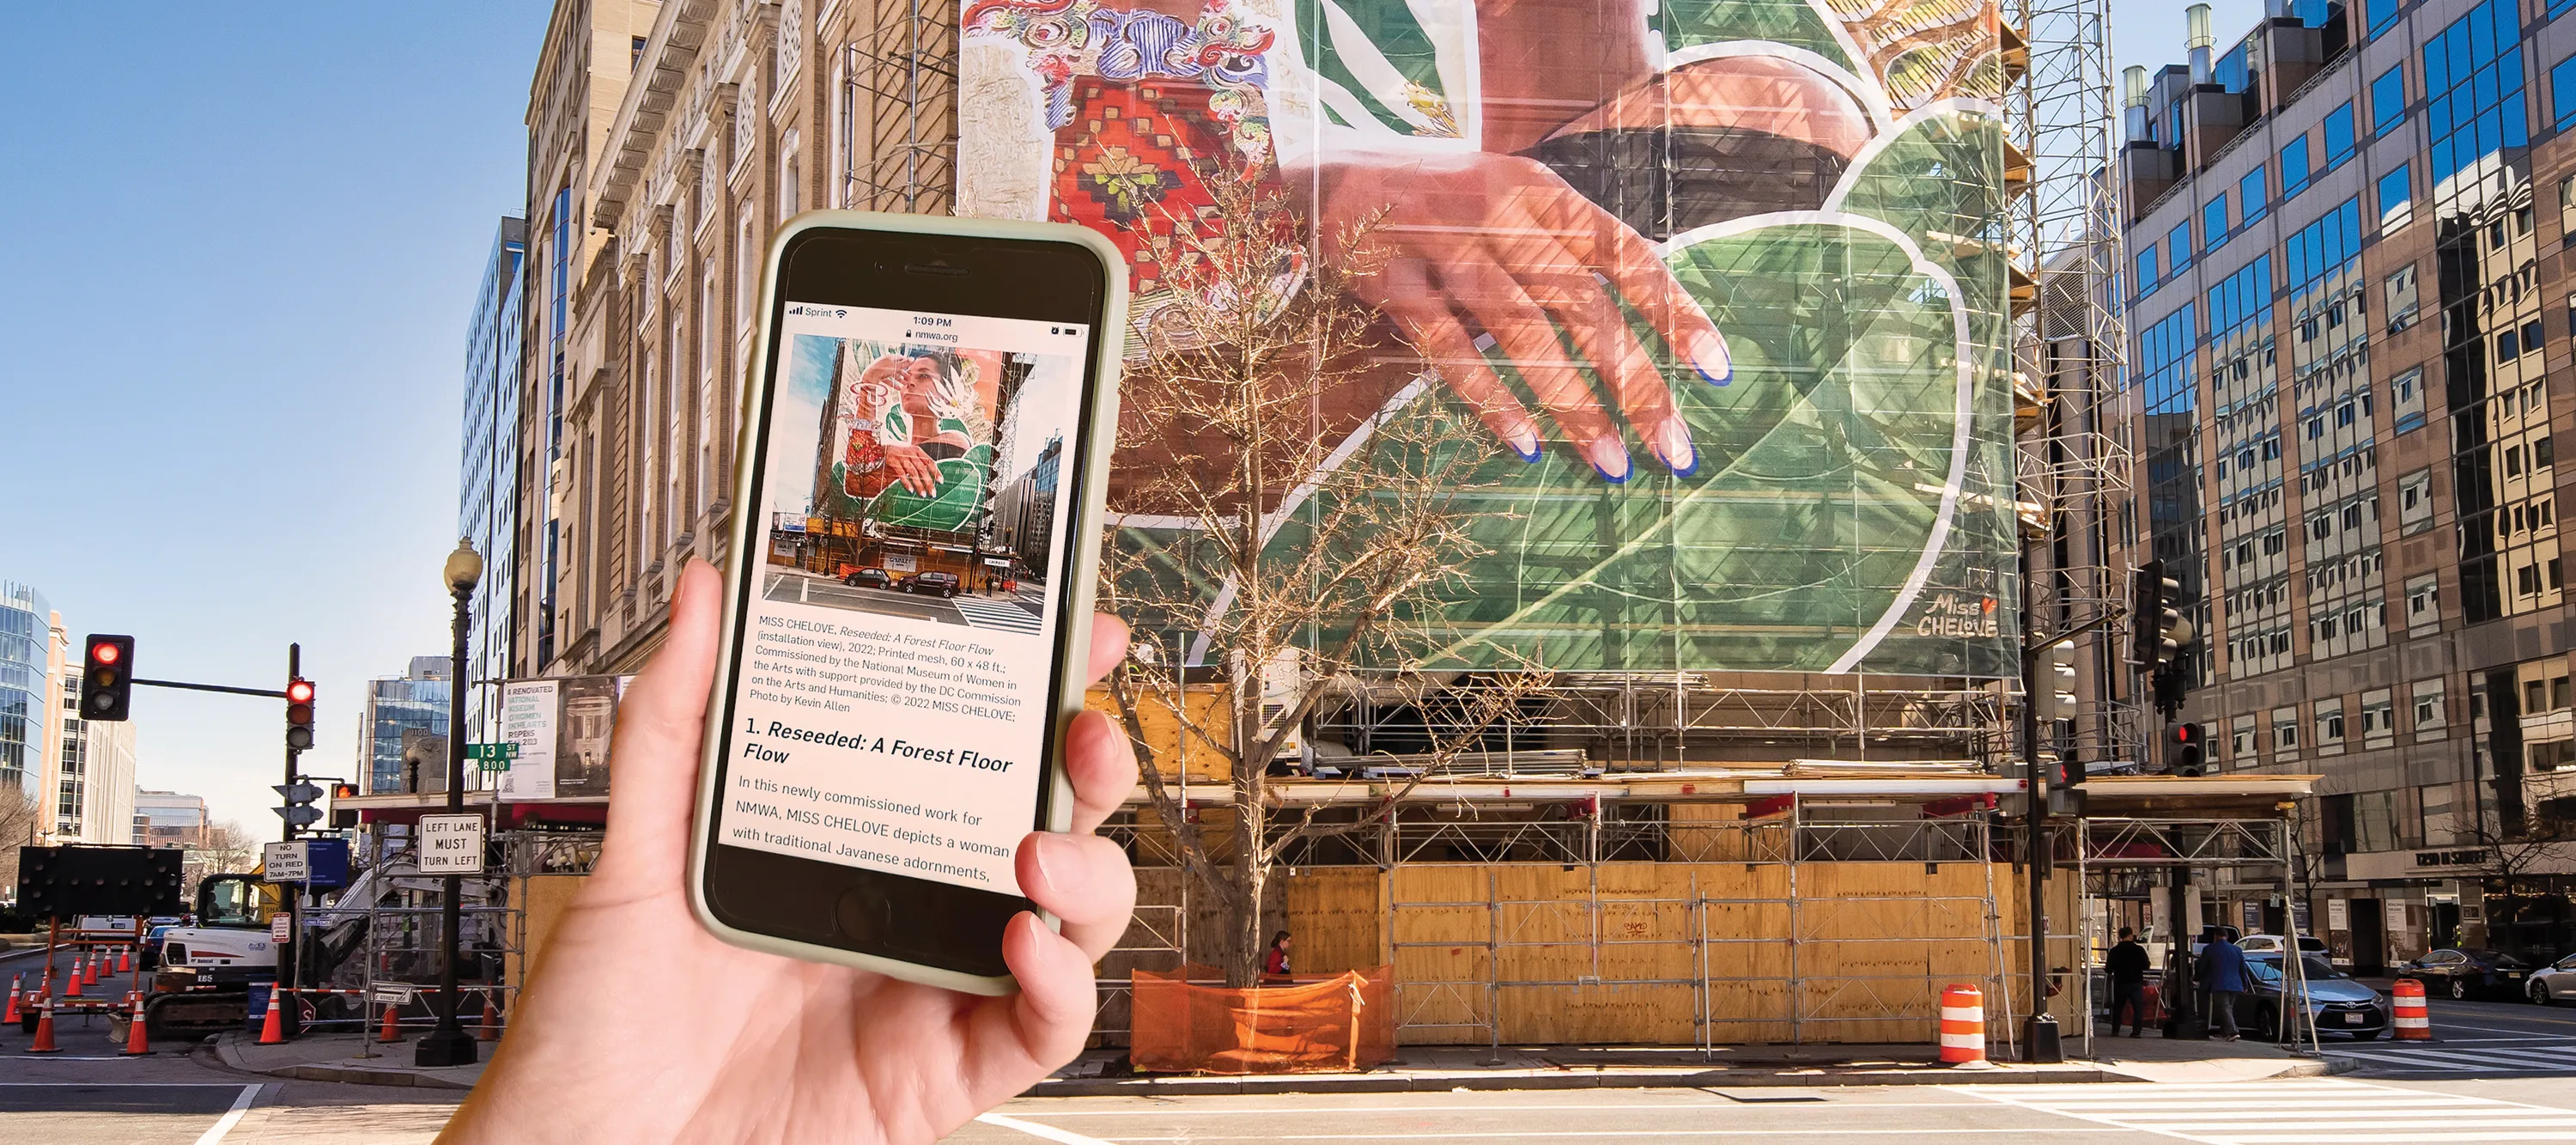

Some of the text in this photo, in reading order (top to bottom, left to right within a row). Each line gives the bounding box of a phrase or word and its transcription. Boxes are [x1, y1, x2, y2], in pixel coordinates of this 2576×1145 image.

[805, 308, 832, 318] Sprint
[913, 316, 952, 327] 1:09 PM
[915, 331, 958, 343] nmwa.org
[1924, 593, 1980, 616] Miss
[759, 616, 994, 655] MISS CHELOVE, Reseeded: A Forest Floor Flow
[1917, 616, 1999, 638] CHELOVE
[758, 630, 814, 646] (installation
[817, 639, 845, 652] view),
[848, 643, 876, 655] 2022;
[878, 647, 914, 660] Printed
[918, 655, 947, 665] mesh,
[951, 656, 964, 667] 60
[976, 661, 989, 670] 48
[993, 662, 1005, 673] ft.;
[756, 645, 1017, 690] Commissioned by the National Museum of Women in
[513, 686, 553, 695] RENOVATED
[754, 661, 1020, 706] the Arts with support provided by the DC Commission
[750, 689, 849, 712] Photo by Kevin Allen
[767, 677, 781, 687] the
[785, 679, 805, 691] Arts
[808, 685, 826, 693] and
[829, 685, 888, 703] Humanities;
[891, 694, 901, 704] ©
[905, 697, 929, 709] 2022
[933, 701, 958, 713] MISS
[962, 704, 1015, 722] CHELOVE;
[480, 745, 495, 758] 13
[744, 743, 790, 764] Flow
[746, 718, 1013, 772] 1. Reseeded: A Forest Floor
[483, 760, 505, 770] 800
[739, 776, 982, 825] In this newly commissioned work for
[426, 822, 477, 832] LEFT LANE
[736, 801, 1009, 857] NMWA, MISS CHELOVE depicts a woman
[435, 838, 467, 850] MUST
[733, 827, 989, 882] with traditional Javanese adornments,
[424, 856, 477, 866] TURN LEFT
